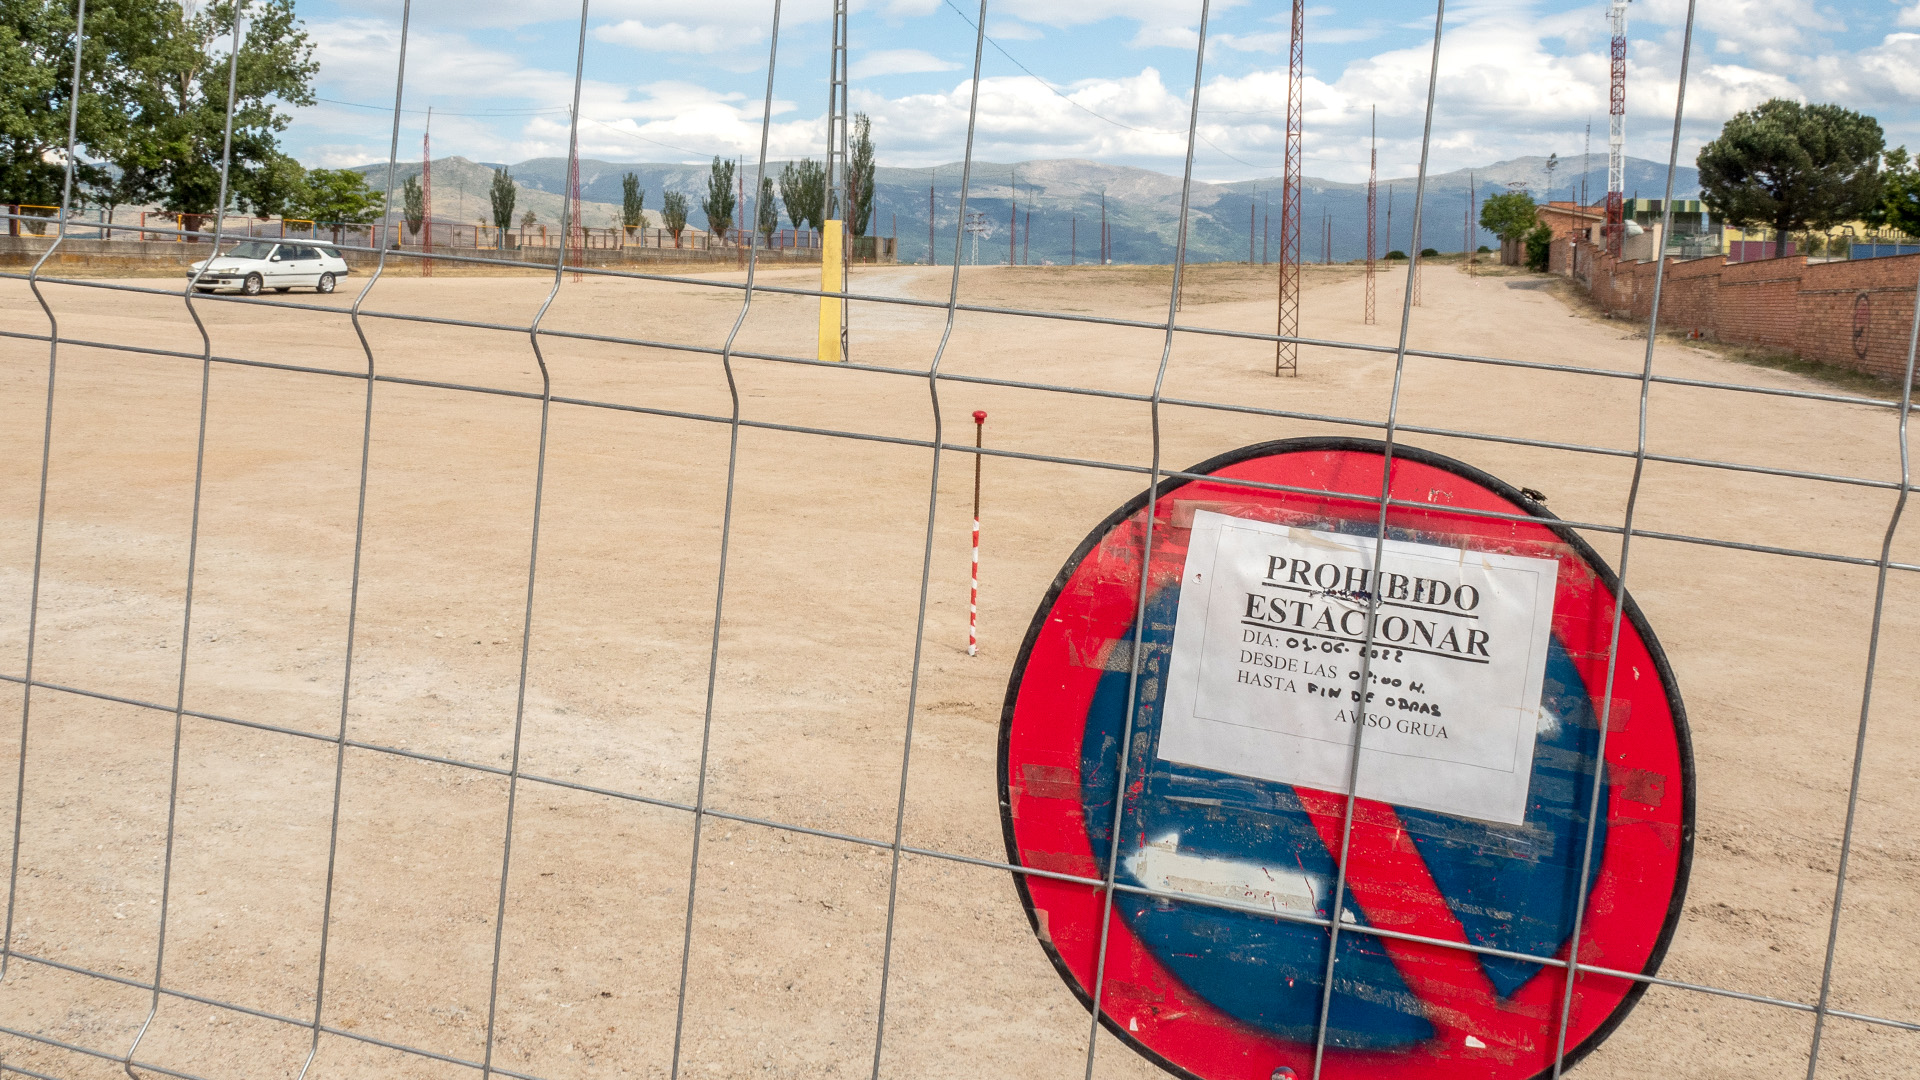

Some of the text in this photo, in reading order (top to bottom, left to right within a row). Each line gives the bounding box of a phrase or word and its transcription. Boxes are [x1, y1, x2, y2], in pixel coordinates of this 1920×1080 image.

[1242, 592, 1491, 658] ESTACIONAR
[1242, 629, 1279, 648] DIA:
[1240, 650, 1299, 673] DESDE
[1303, 661, 1338, 679] LAS
[1237, 669, 1442, 717] HASTA FIN DE OBRAS
[1334, 709, 1449, 739] AVISO GRUA
